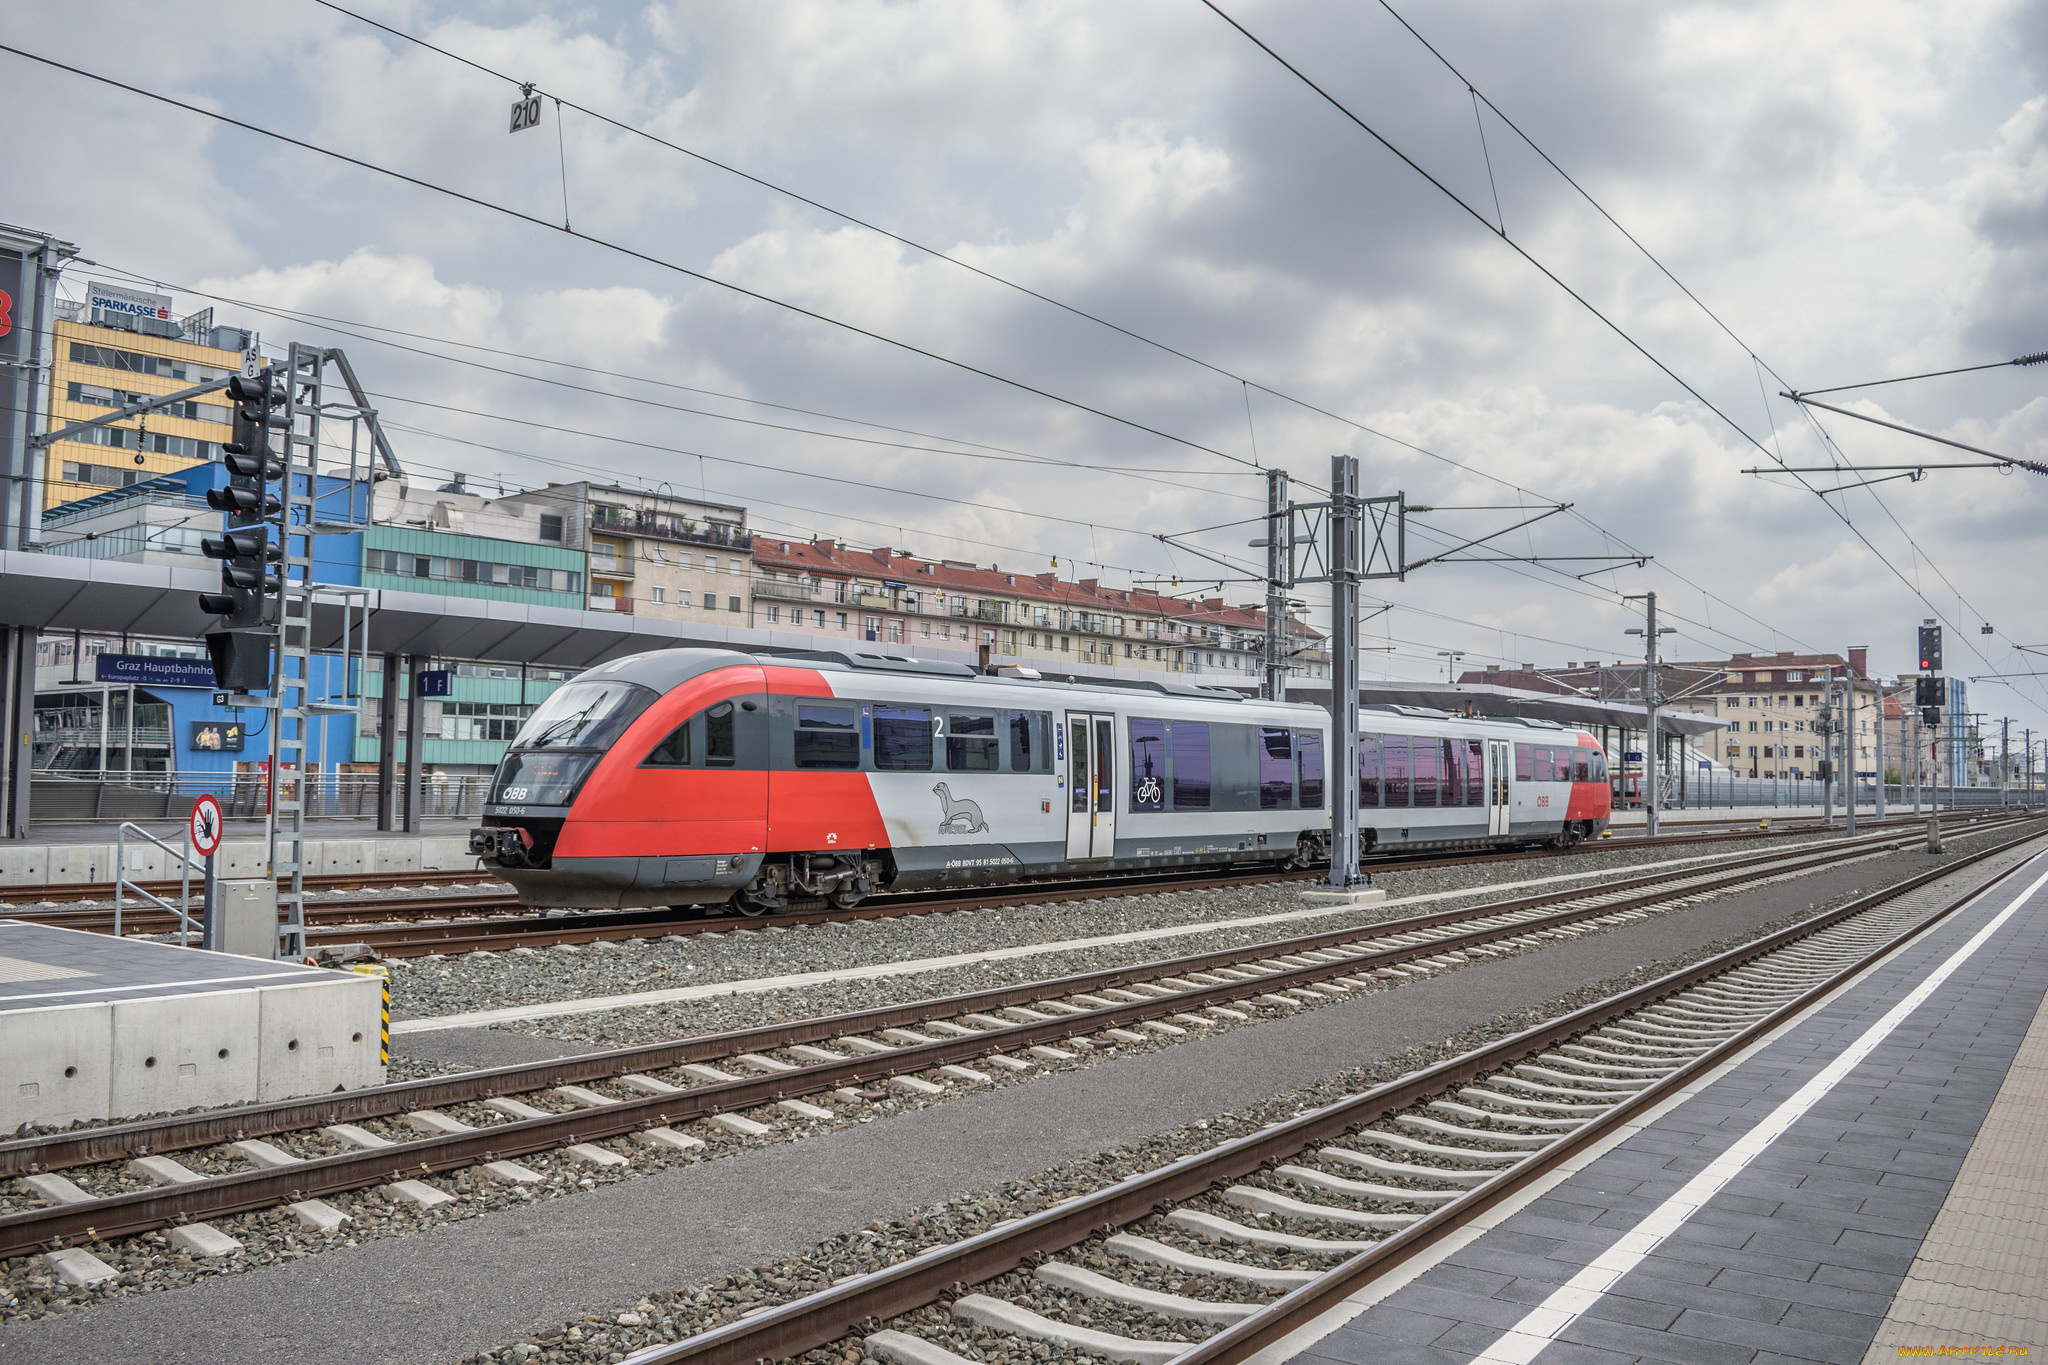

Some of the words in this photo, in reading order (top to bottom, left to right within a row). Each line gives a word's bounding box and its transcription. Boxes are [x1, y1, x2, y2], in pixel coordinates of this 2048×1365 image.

[512, 99, 539, 129] 210
[92, 287, 157, 306] Steiermärkische
[91, 296, 156, 317] SPARKASSE
[245, 348, 257, 363] AS
[247, 364, 254, 377] G
[116, 661, 140, 671] Graz
[143, 662, 217, 675] Hauptbahnho
[423, 676, 428, 692] 1
[437, 679, 443, 692] F
[216, 695, 225, 703] G3
[934, 716, 944, 738] 2
[494, 806, 508, 814] 5022
[508, 806, 526, 815] 050-6
